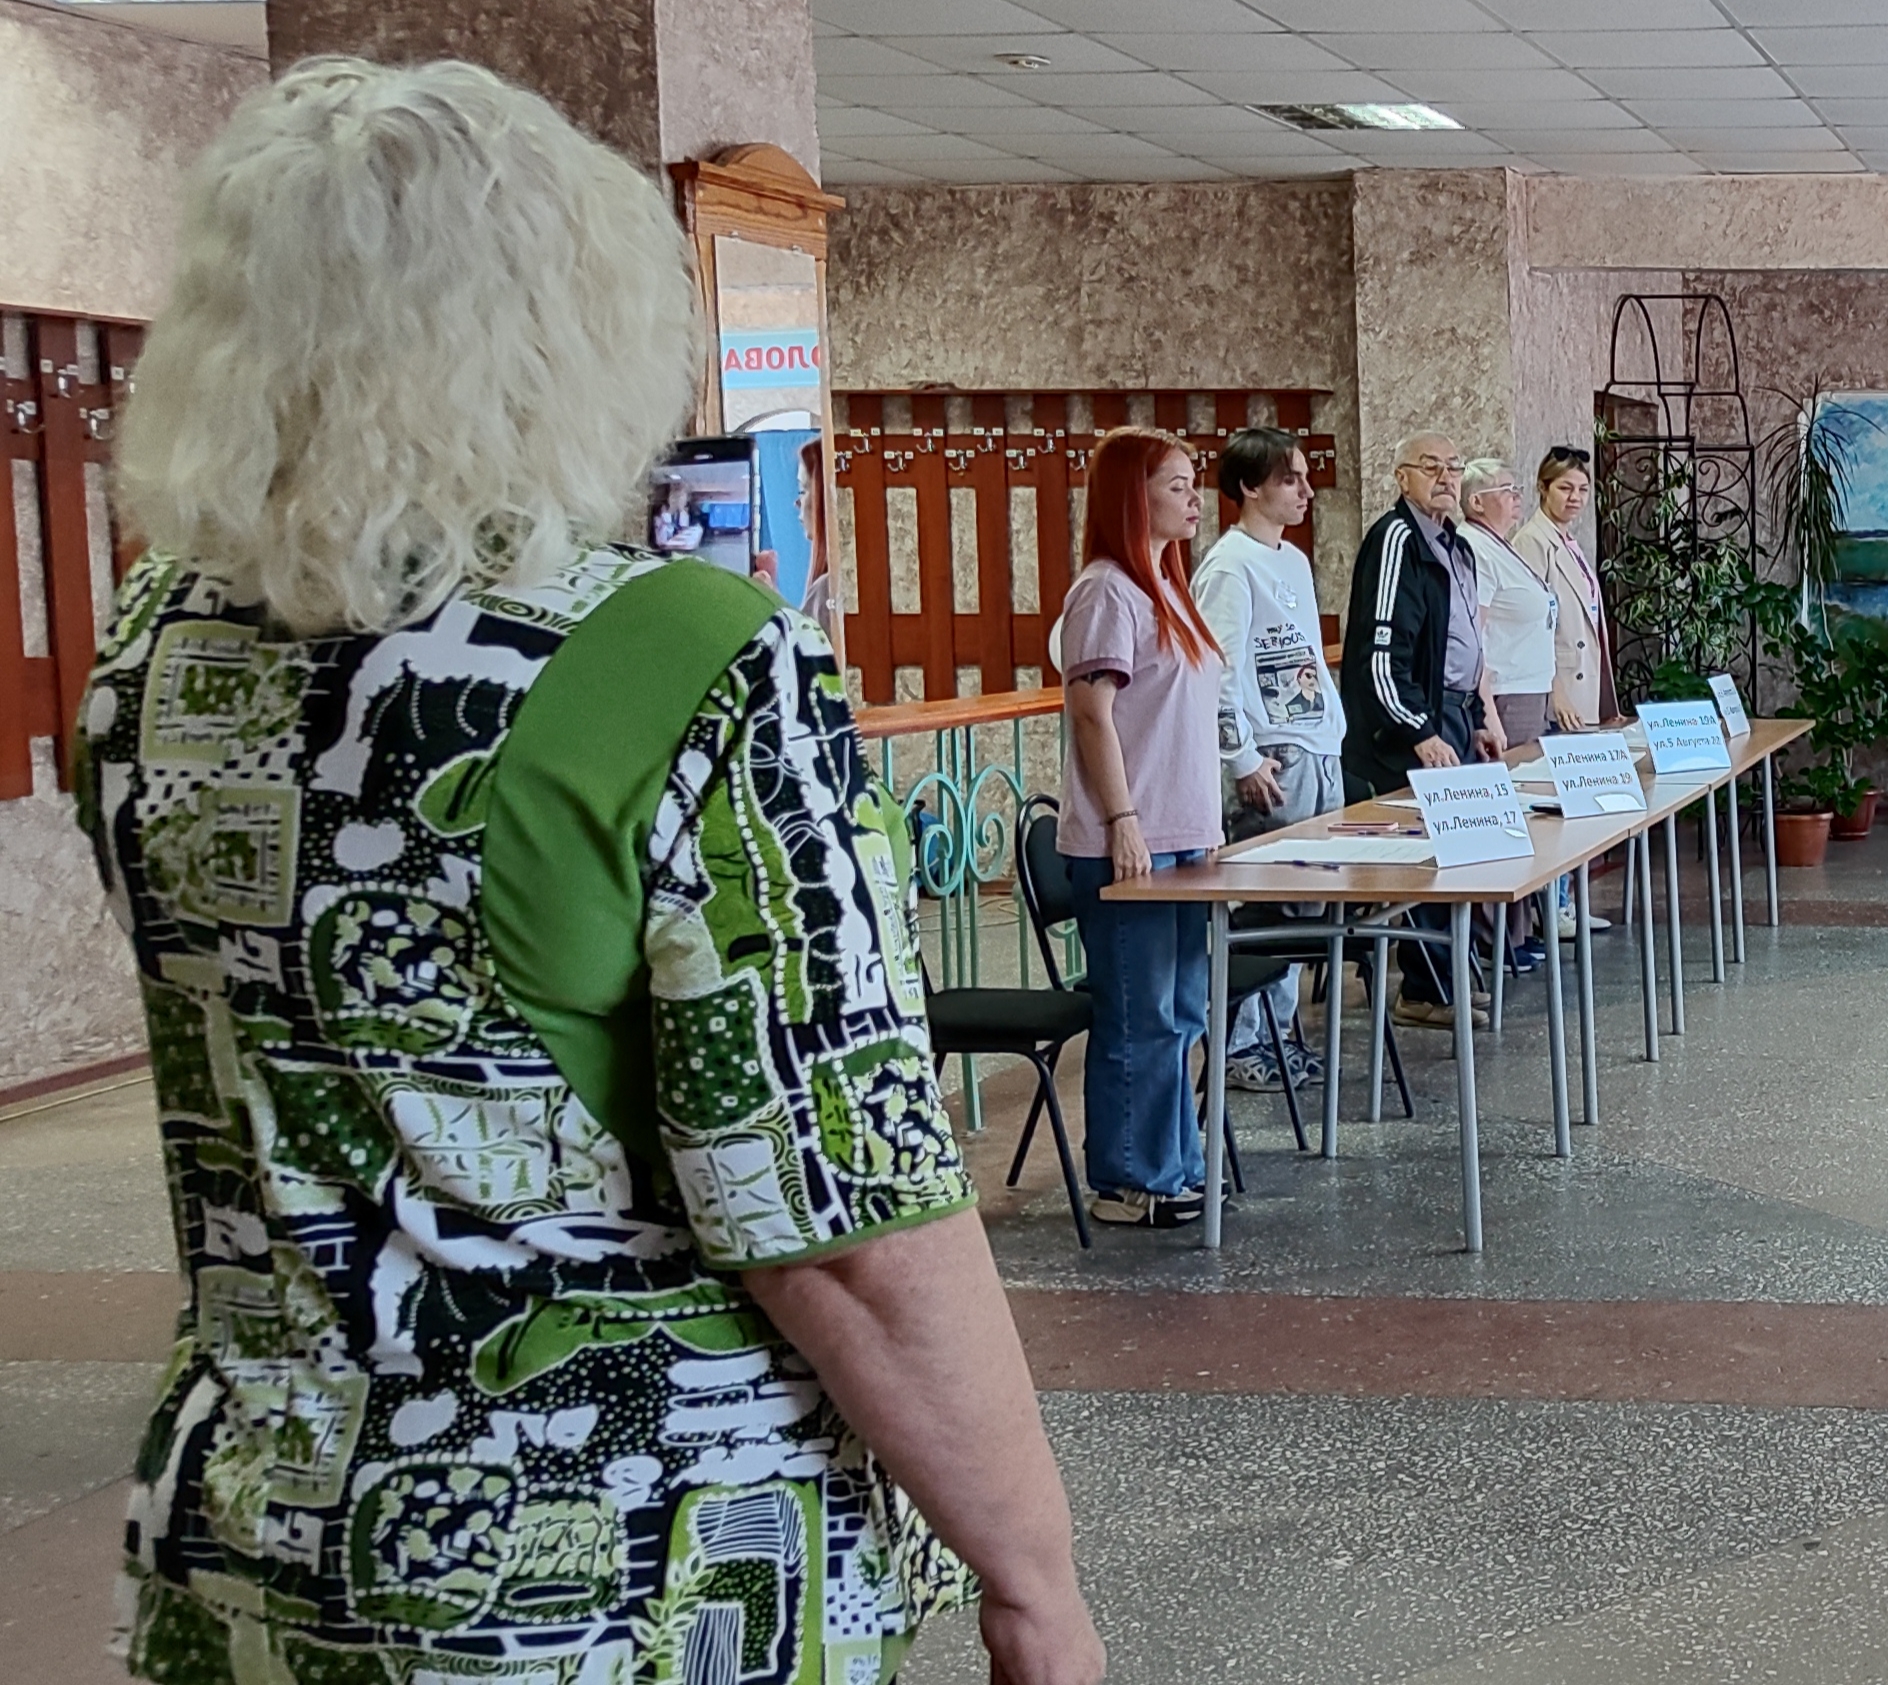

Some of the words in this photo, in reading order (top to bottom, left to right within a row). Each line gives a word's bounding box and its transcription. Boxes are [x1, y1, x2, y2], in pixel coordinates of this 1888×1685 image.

[1550, 752, 1607, 768] ул.Ленина
[1608, 749, 1628, 762] 17А
[1562, 775, 1618, 791] ул.Ленина
[1619, 772, 1632, 785] 19
[1424, 787, 1494, 807] ул.Ленина,
[1495, 783, 1509, 797] 15
[1433, 815, 1503, 835] ул.Ленина,
[1504, 811, 1516, 824] 17
